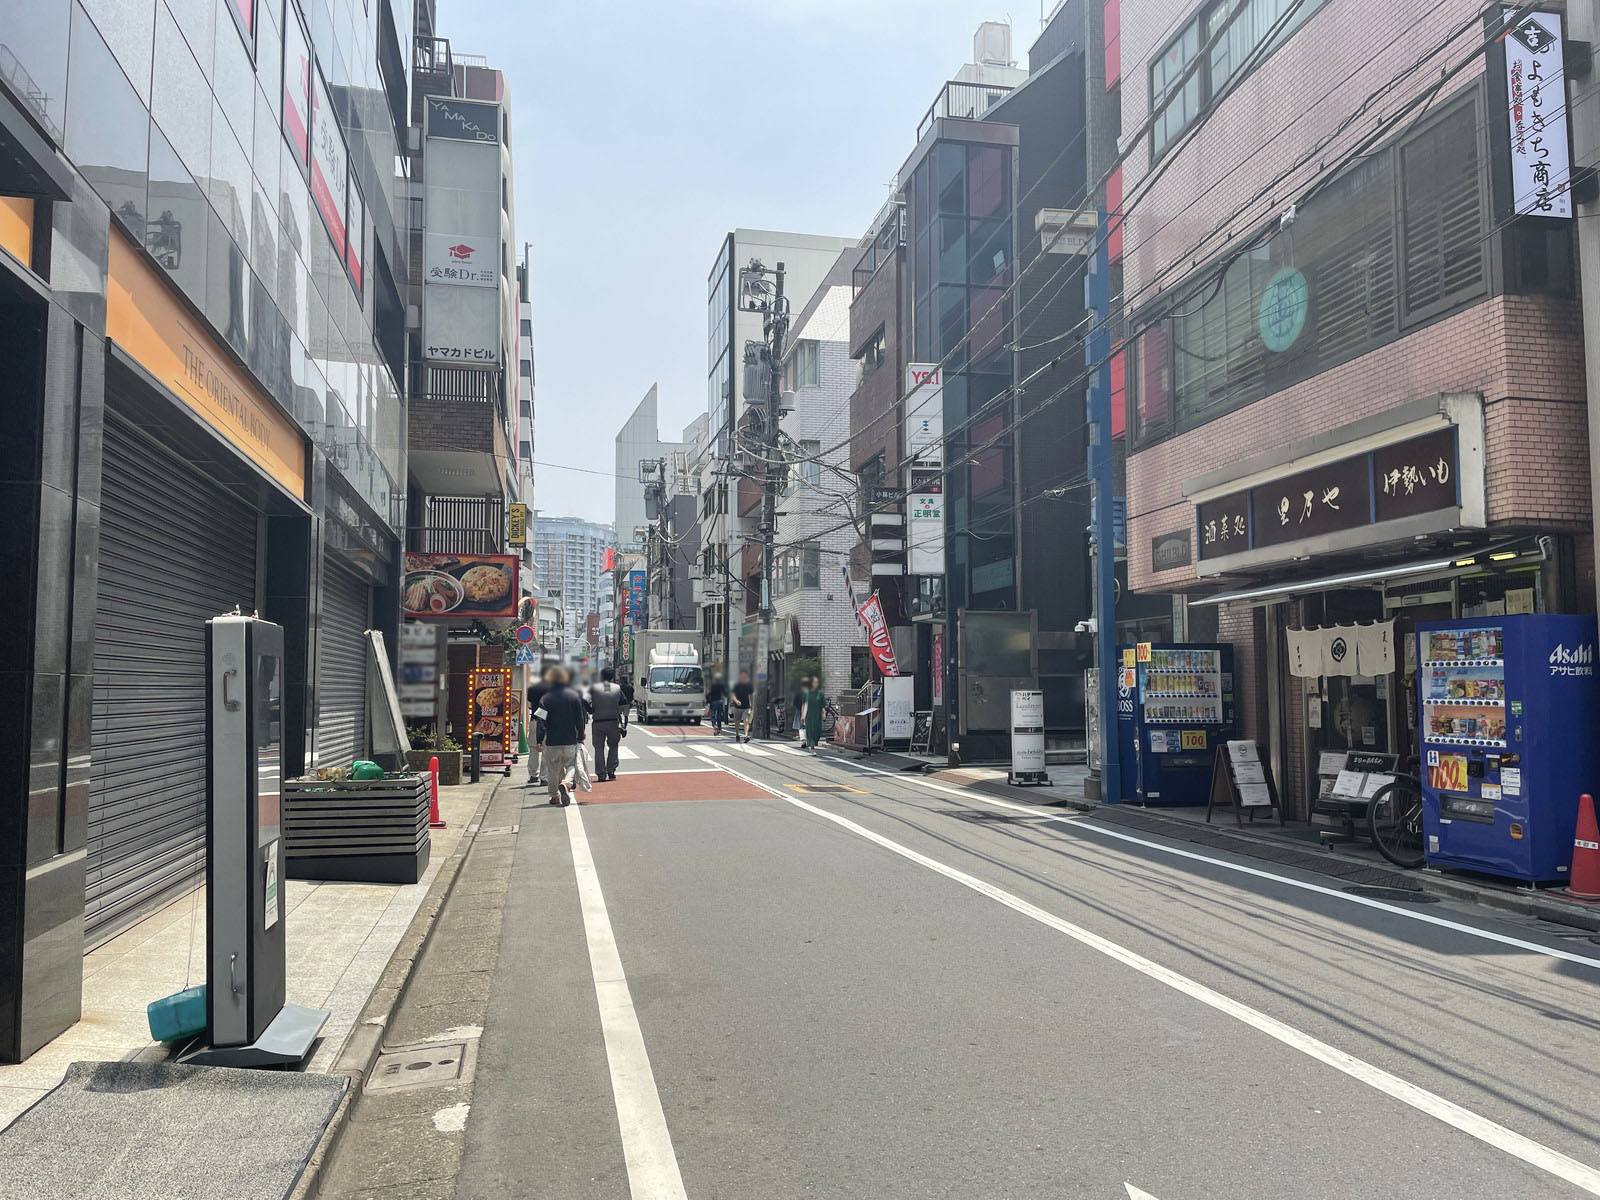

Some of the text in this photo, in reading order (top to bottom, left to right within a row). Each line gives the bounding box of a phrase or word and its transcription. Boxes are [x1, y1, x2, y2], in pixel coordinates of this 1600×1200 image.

[1524, 26, 1541, 47] 吉
[427, 346, 495, 360] ヤマカドビル
[183, 344, 271, 452] THE ORIENTAL BODY
[1383, 456, 1449, 497] 伊勢いも
[511, 508, 520, 539] DICKEY'S
[1549, 643, 1592, 664] Asahi
[1549, 666, 1593, 676] アサヒ飲料
[1118, 699, 1134, 712] OSS
[1186, 735, 1204, 746] 100
